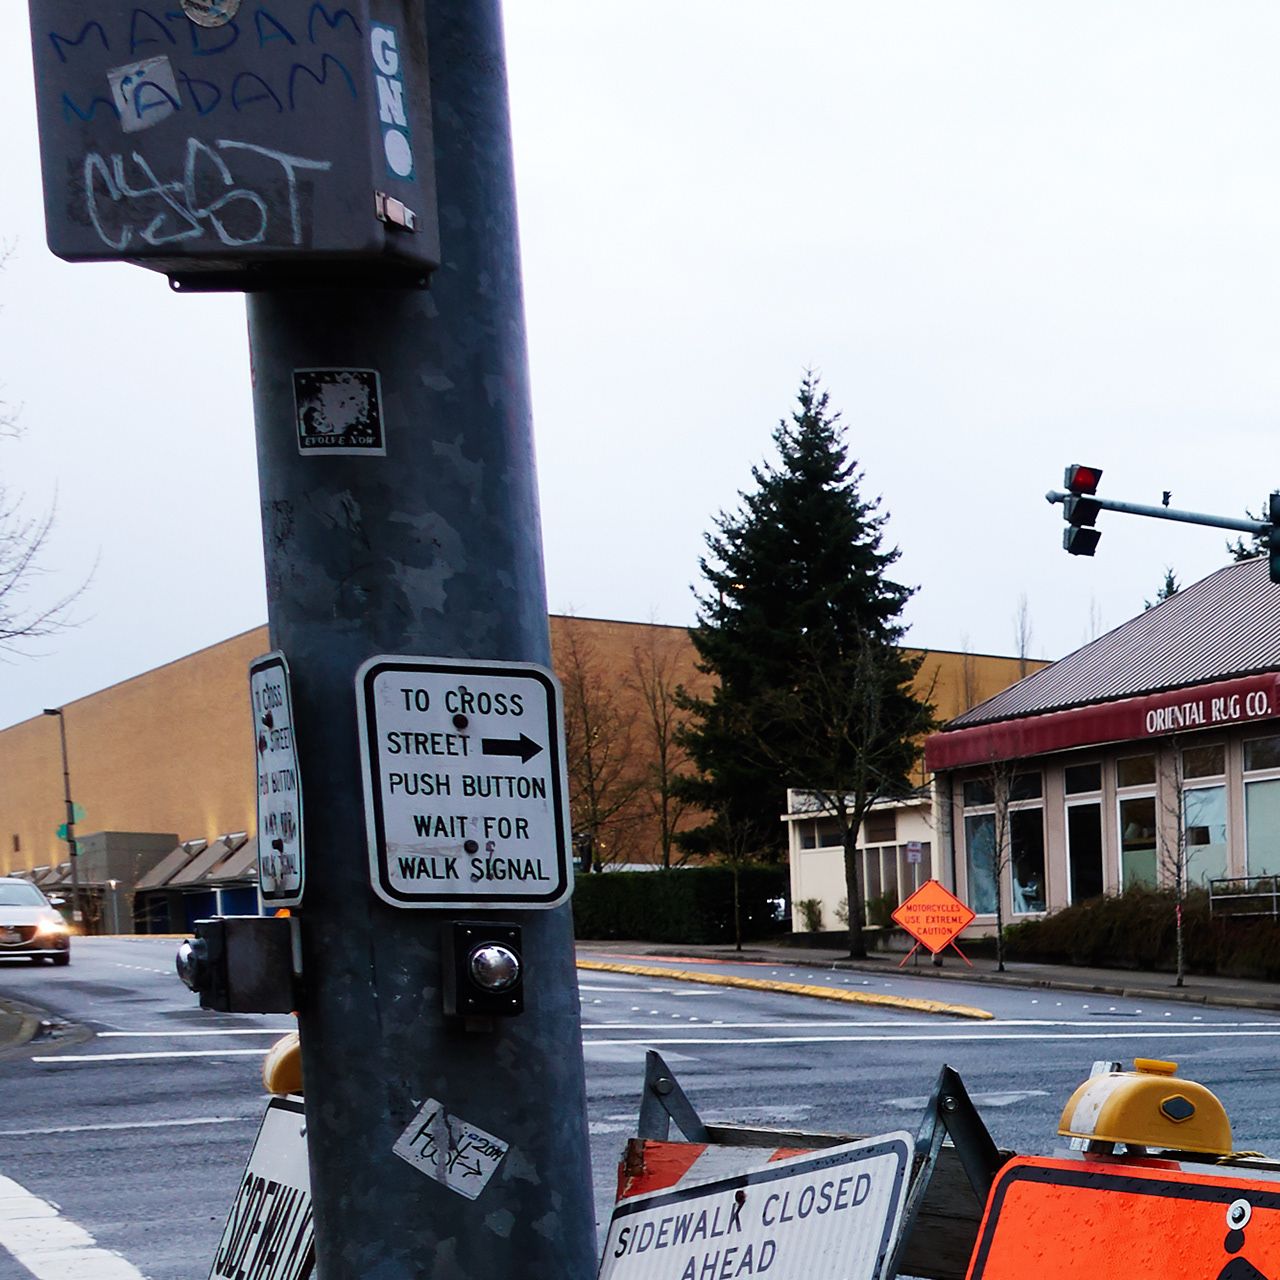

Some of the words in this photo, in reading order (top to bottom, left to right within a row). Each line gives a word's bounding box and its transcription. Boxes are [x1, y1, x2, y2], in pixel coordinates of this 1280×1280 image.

[400, 688, 430, 712] TO
[445, 690, 524, 716] CROSS
[1146, 700, 1206, 733] ORIENTAL
[1211, 694, 1240, 721] RUG
[1245, 691, 1272, 716] CO.
[387, 732, 470, 756] STREET
[389, 773, 450, 796] PUSH
[462, 775, 546, 799] BUTTON
[413, 815, 468, 838] WAIT
[484, 817, 529, 839] FOR
[398, 857, 460, 880] WALK
[470, 858, 550, 881] SIGNAL
[904, 916, 920, 924] USE
[925, 916, 963, 924] EXTREME
[906, 904, 961, 912] MOTORCYCLES
[917, 927, 953, 935] CAUTION
[614, 1201, 742, 1258] SIDEWALK
[762, 1173, 872, 1227] CLOSED
